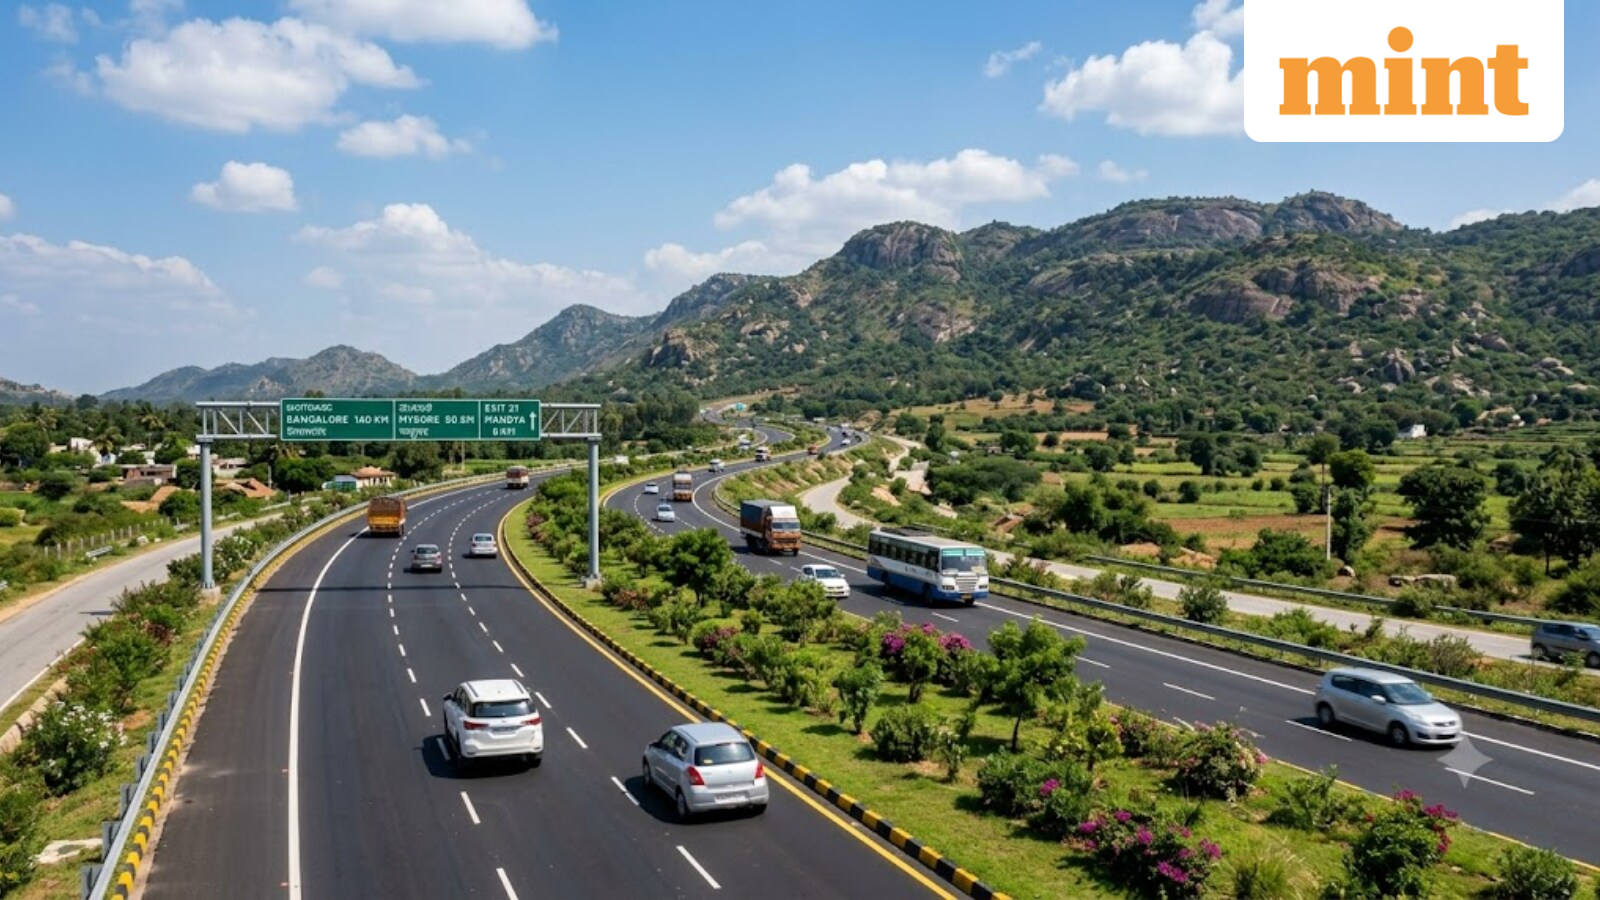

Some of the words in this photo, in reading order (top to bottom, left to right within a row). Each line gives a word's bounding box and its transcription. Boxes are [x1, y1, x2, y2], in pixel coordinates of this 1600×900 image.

[508, 404, 519, 413] 21
[286, 415, 349, 424] BANGALORE
[354, 415, 372, 424] 140
[374, 415, 389, 424] KM
[484, 415, 526, 424] MANDYA
